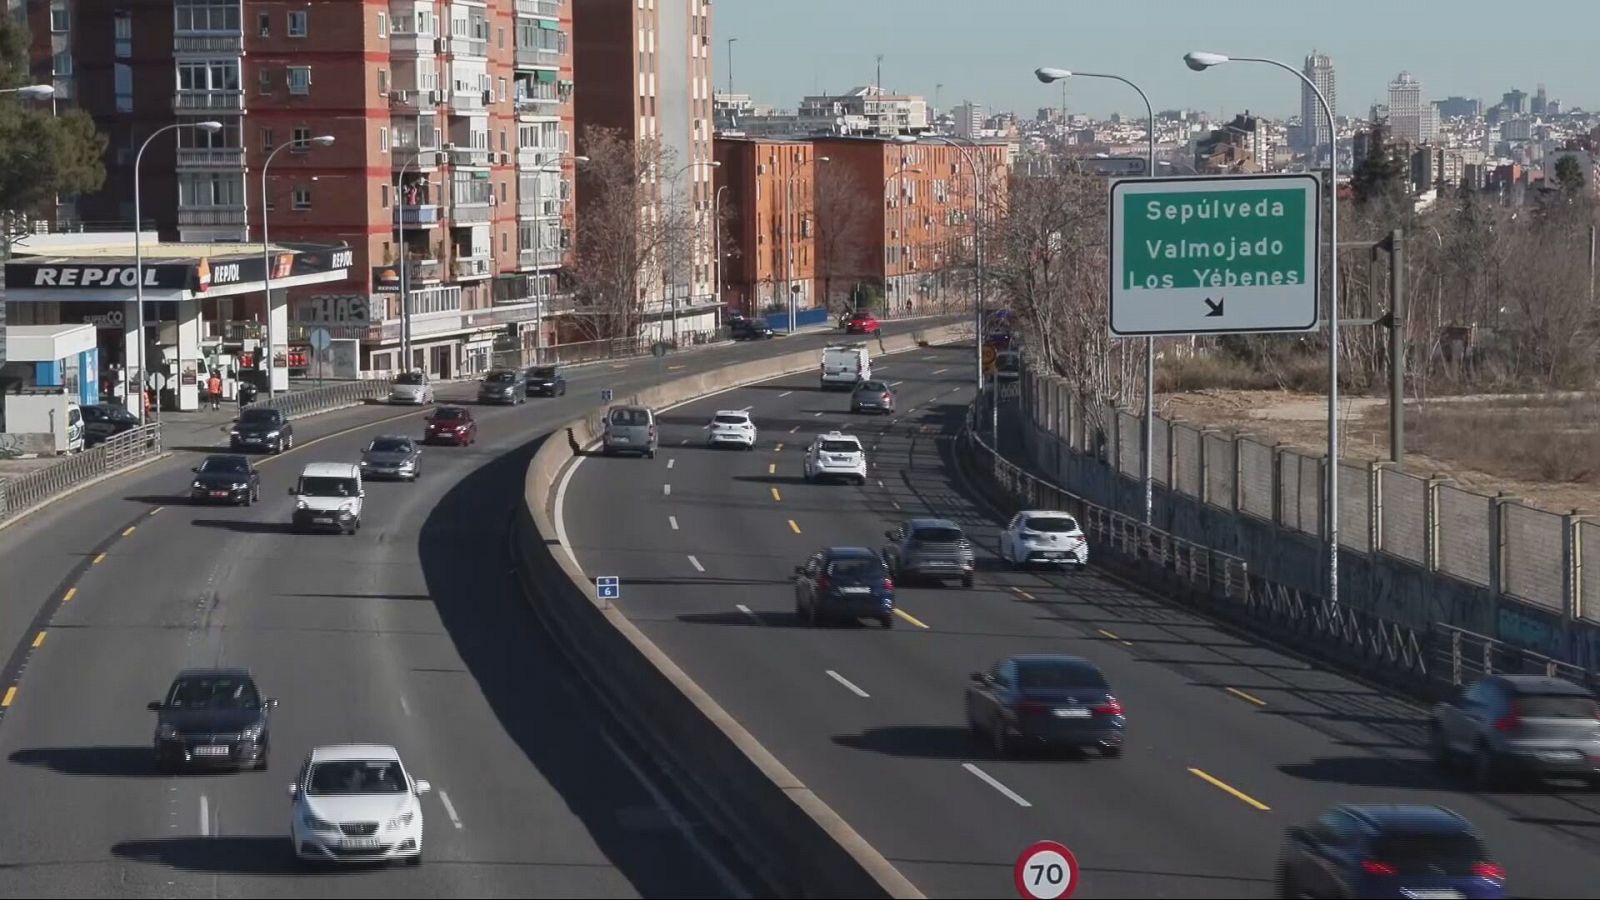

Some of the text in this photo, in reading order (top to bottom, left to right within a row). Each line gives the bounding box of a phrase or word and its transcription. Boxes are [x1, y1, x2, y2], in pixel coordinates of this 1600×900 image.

[1146, 198, 1285, 225] Sepúlveda
[1146, 236, 1284, 261] Valmojado
[332, 250, 353, 269] REPSOL
[34, 267, 160, 286] REPSOL
[214, 263, 240, 284] REPSOL
[1129, 268, 1299, 290] Los Yébenes
[604, 587, 612, 596] 6
[1030, 863, 1064, 886] 70
